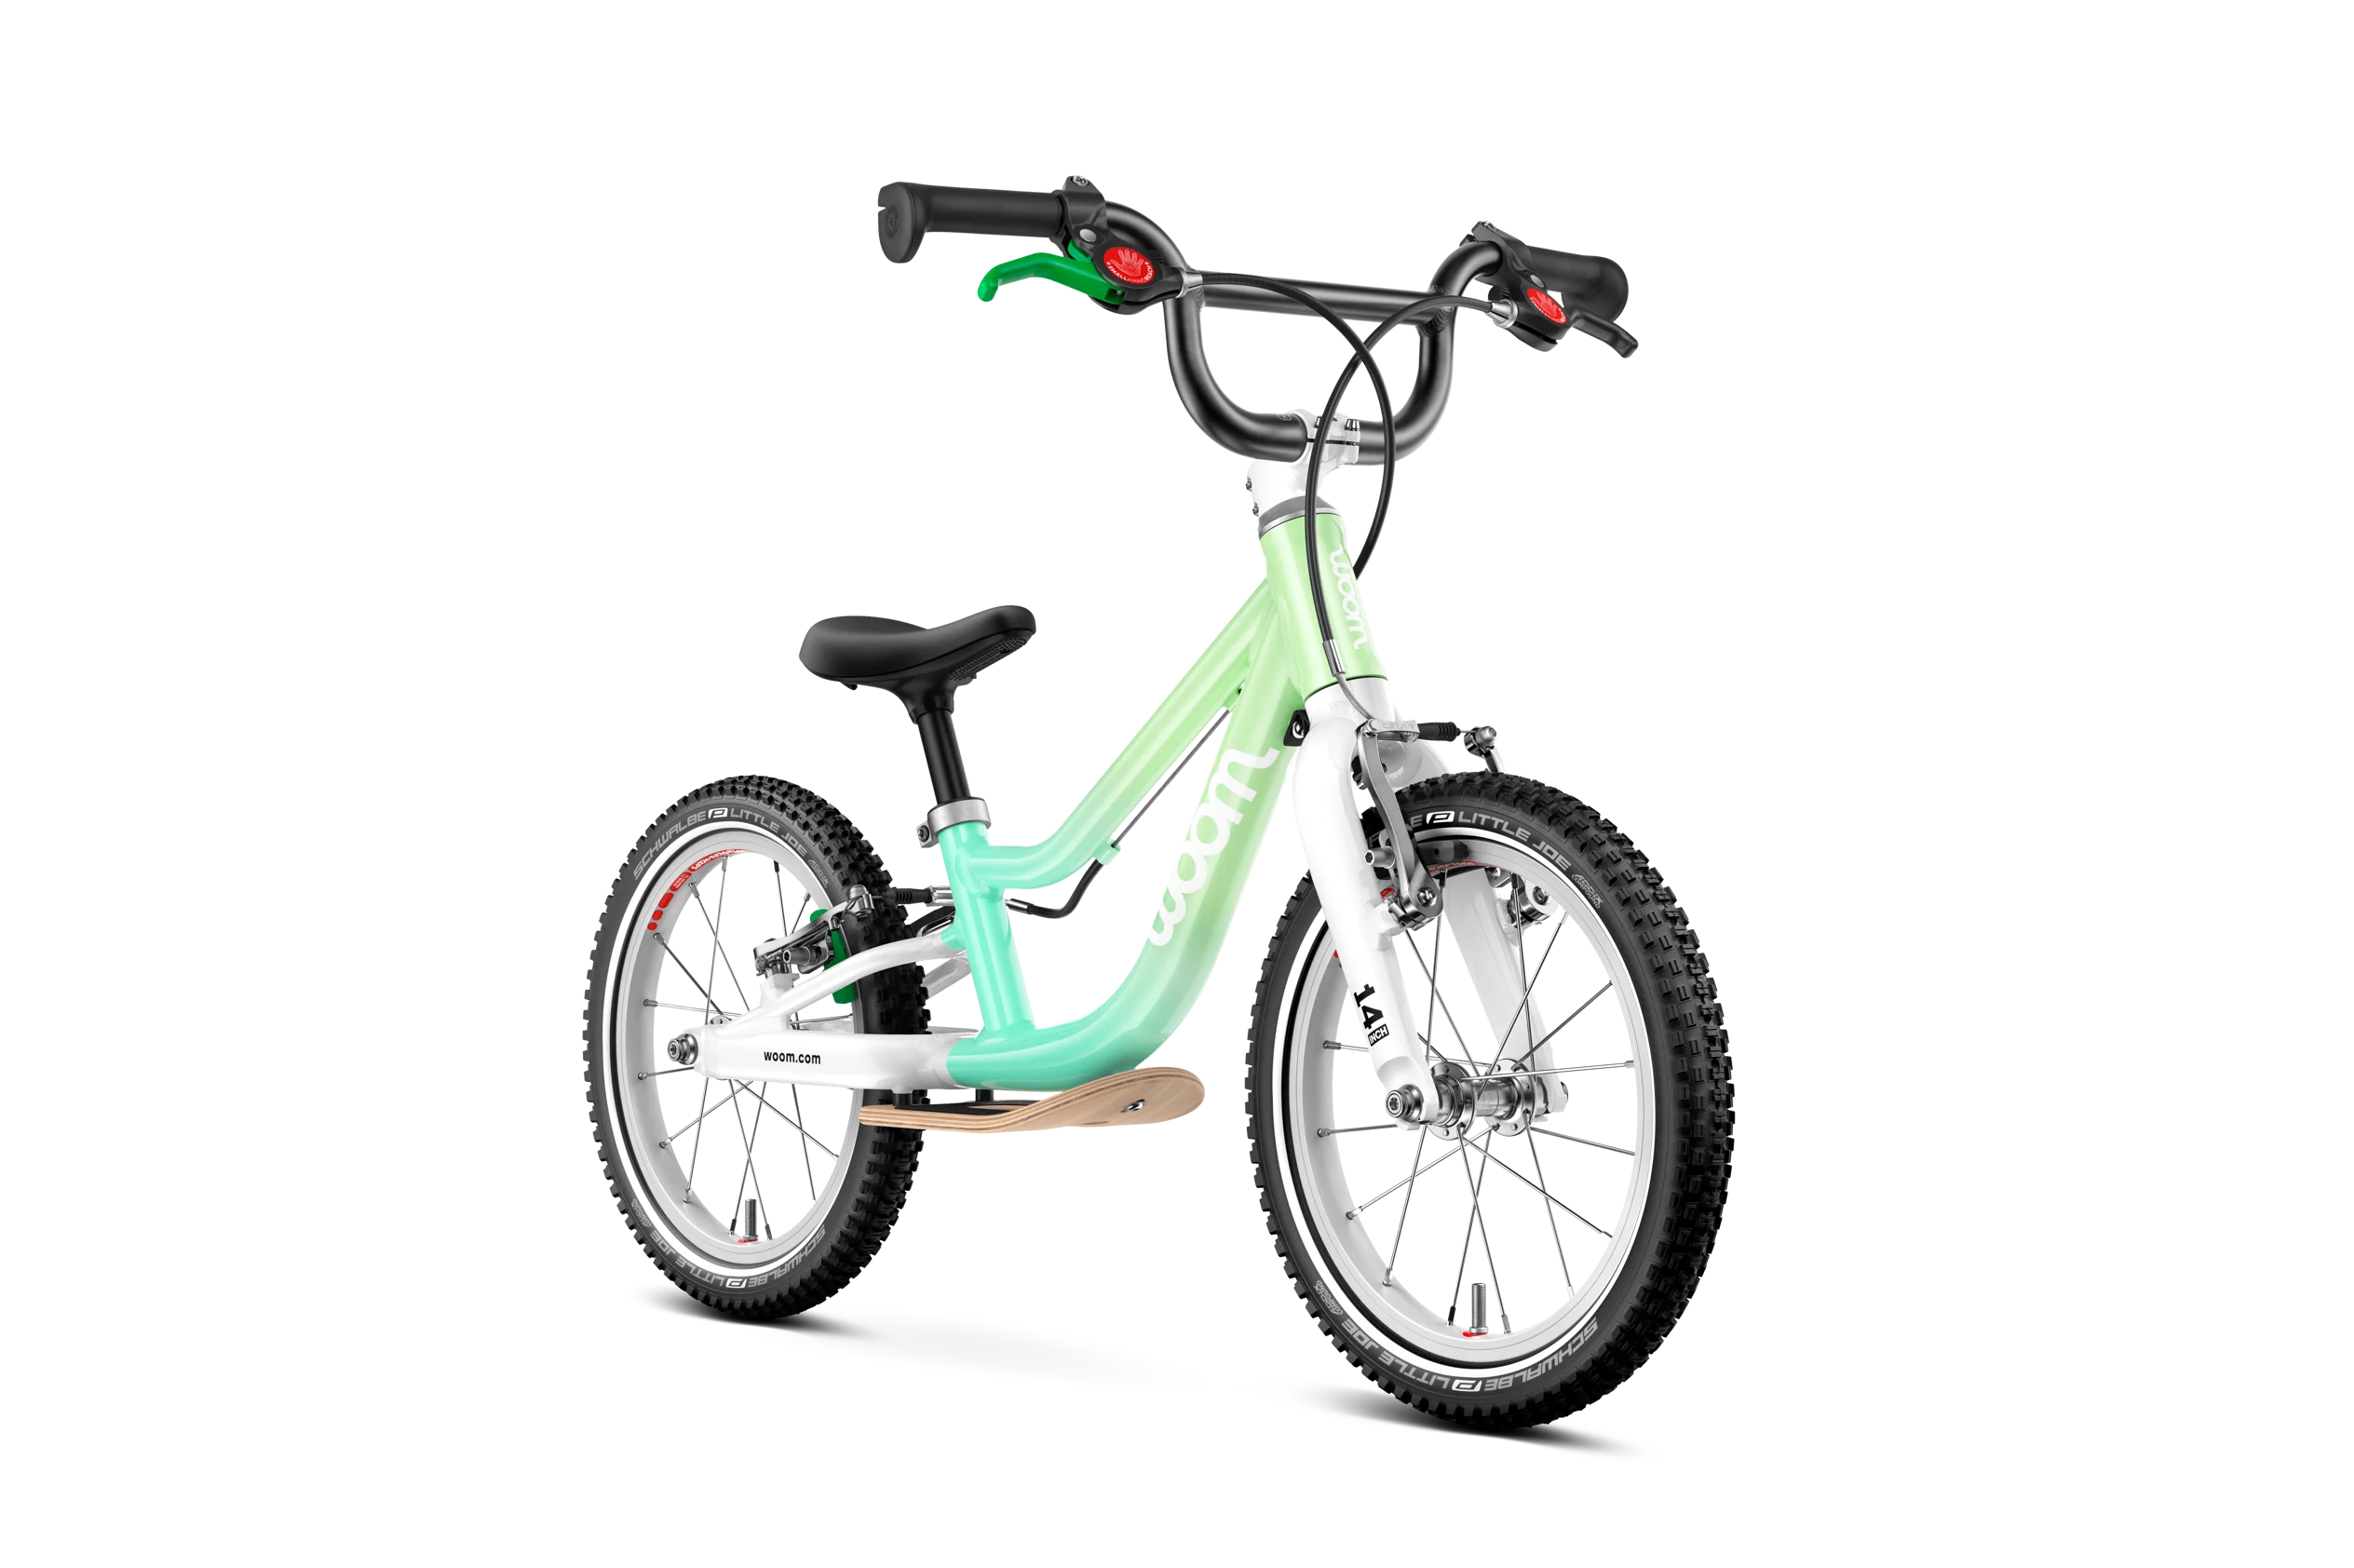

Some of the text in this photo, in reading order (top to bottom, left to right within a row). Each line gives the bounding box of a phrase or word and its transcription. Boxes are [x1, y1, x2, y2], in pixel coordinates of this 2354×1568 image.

[1329, 544, 1369, 650] woom
[633, 810, 707, 881] SCHWALBE
[730, 807, 780, 833] LITTLE
[780, 831, 808, 858] JOE
[1146, 747, 1281, 947] woom
[1458, 811, 1532, 843] LITTLE
[1532, 840, 1572, 872] JOE
[1353, 983, 1384, 1030] 14
[764, 1051, 821, 1065] woom.com
[1369, 1024, 1388, 1046] INCH
[650, 1229, 676, 1257] JOE
[748, 1224, 826, 1288] SCHWALBE
[675, 1256, 725, 1287] LITTLE
[1341, 1318, 1380, 1350] JOE
[1483, 1316, 1599, 1392] SCHWALBE
[1377, 1350, 1451, 1389] LITTLE
